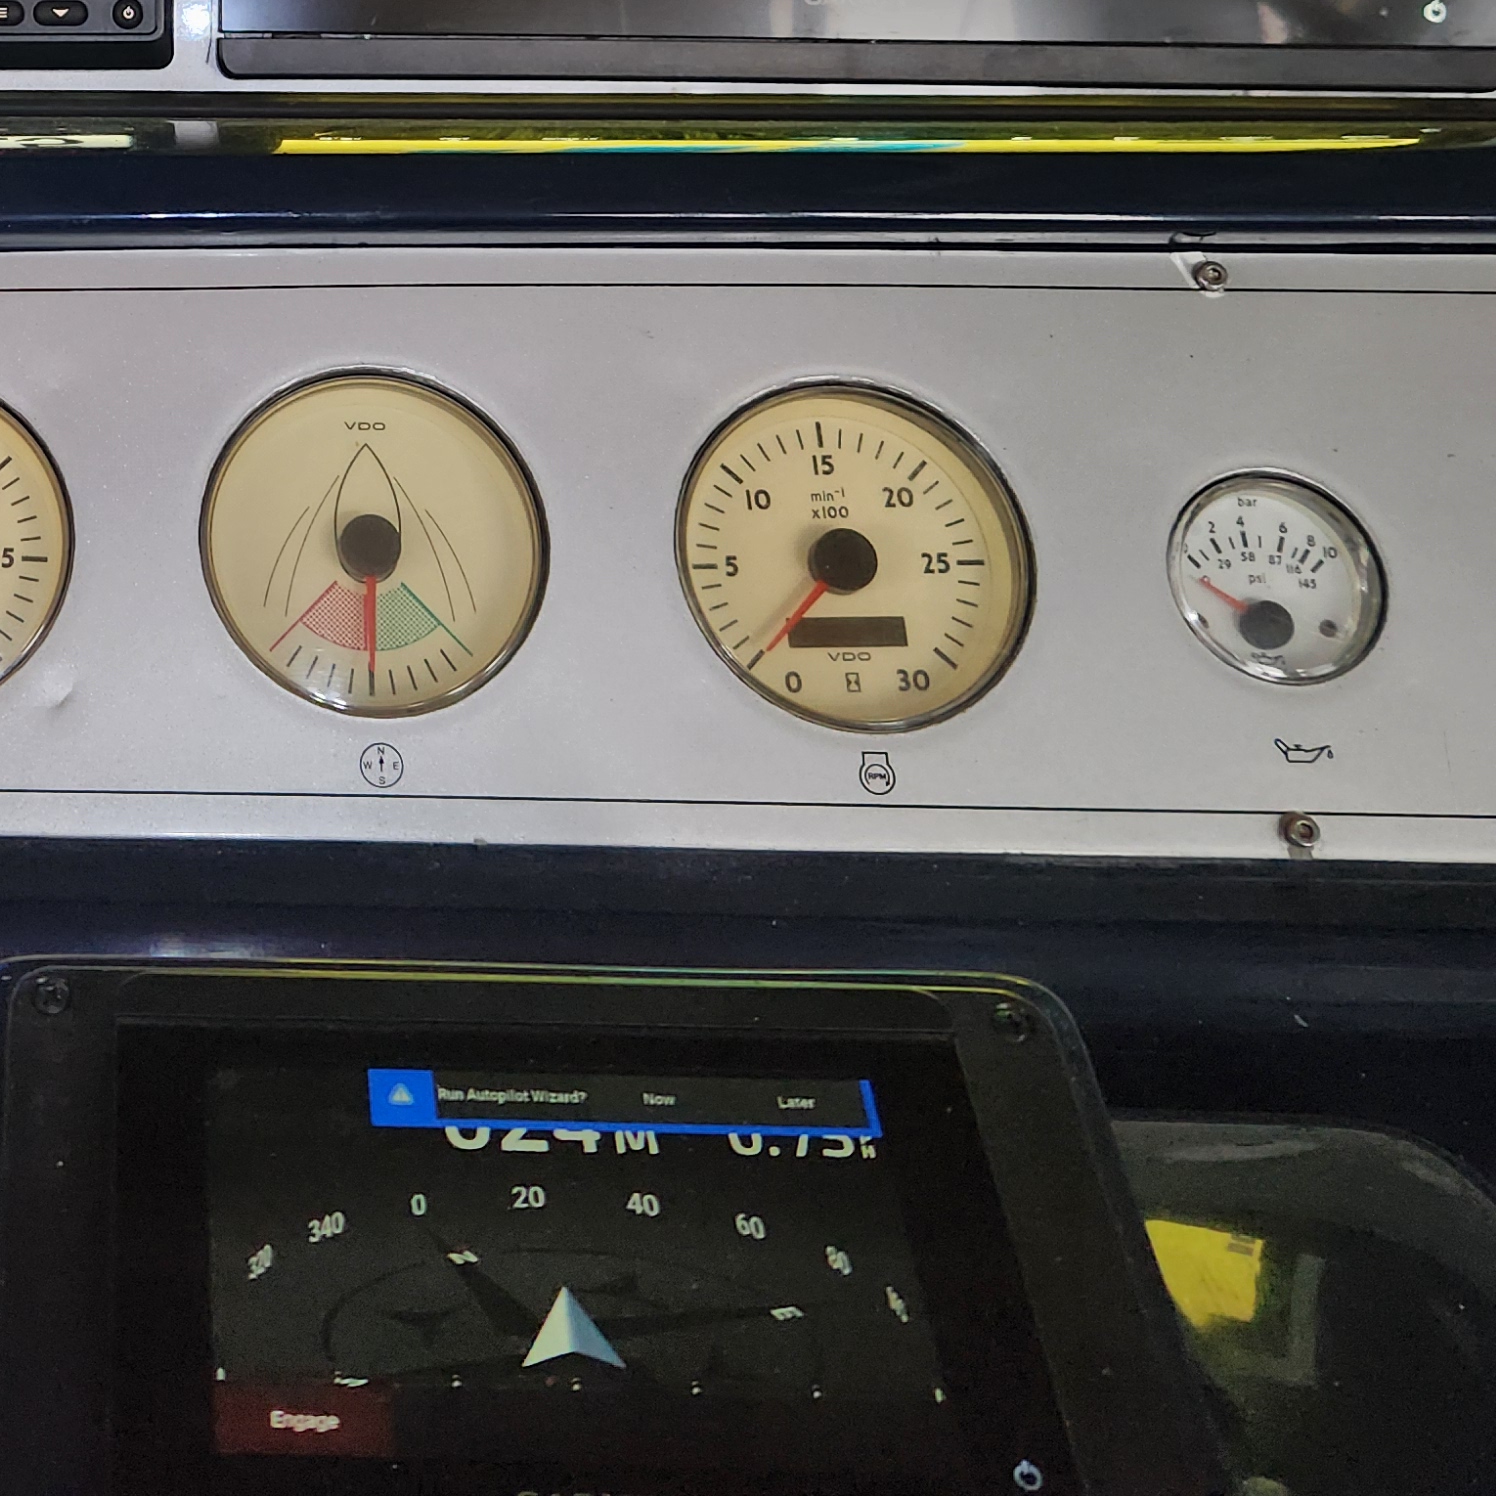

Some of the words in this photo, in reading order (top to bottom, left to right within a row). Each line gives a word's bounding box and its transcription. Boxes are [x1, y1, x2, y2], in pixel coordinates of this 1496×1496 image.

[344, 421, 386, 431] VDO
[812, 455, 835, 476] 15
[745, 489, 771, 510] 10
[882, 487, 913, 508] 20
[1237, 497, 1258, 508] bar
[1208, 521, 1216, 533] 2
[1236, 516, 1245, 528] 4
[1279, 522, 1288, 534] 6
[1307, 534, 1316, 547] 8
[1241, 551, 1256, 562] 58
[1322, 546, 1338, 559] 10
[725, 556, 739, 577] 5
[921, 552, 951, 574] 25
[1218, 559, 1232, 570] 29
[1268, 555, 1282, 566] 87
[827, 651, 872, 662] VDO
[785, 672, 802, 694] 0
[896, 669, 931, 692] 30
[377, 747, 385, 756] N
[868, 772, 887, 781] RPM
[437, 1087, 465, 1102] Run
[467, 1087, 529, 1104] Autopilot
[530, 1089, 588, 1104] Wizard?
[642, 1092, 676, 1106] Now
[777, 1095, 816, 1109] Later
[511, 1185, 545, 1209] 20
[410, 1193, 427, 1216] 0
[625, 1192, 661, 1217] 40
[308, 1210, 345, 1243] 340
[734, 1213, 766, 1240] 60
[270, 1410, 341, 1433] Engage
